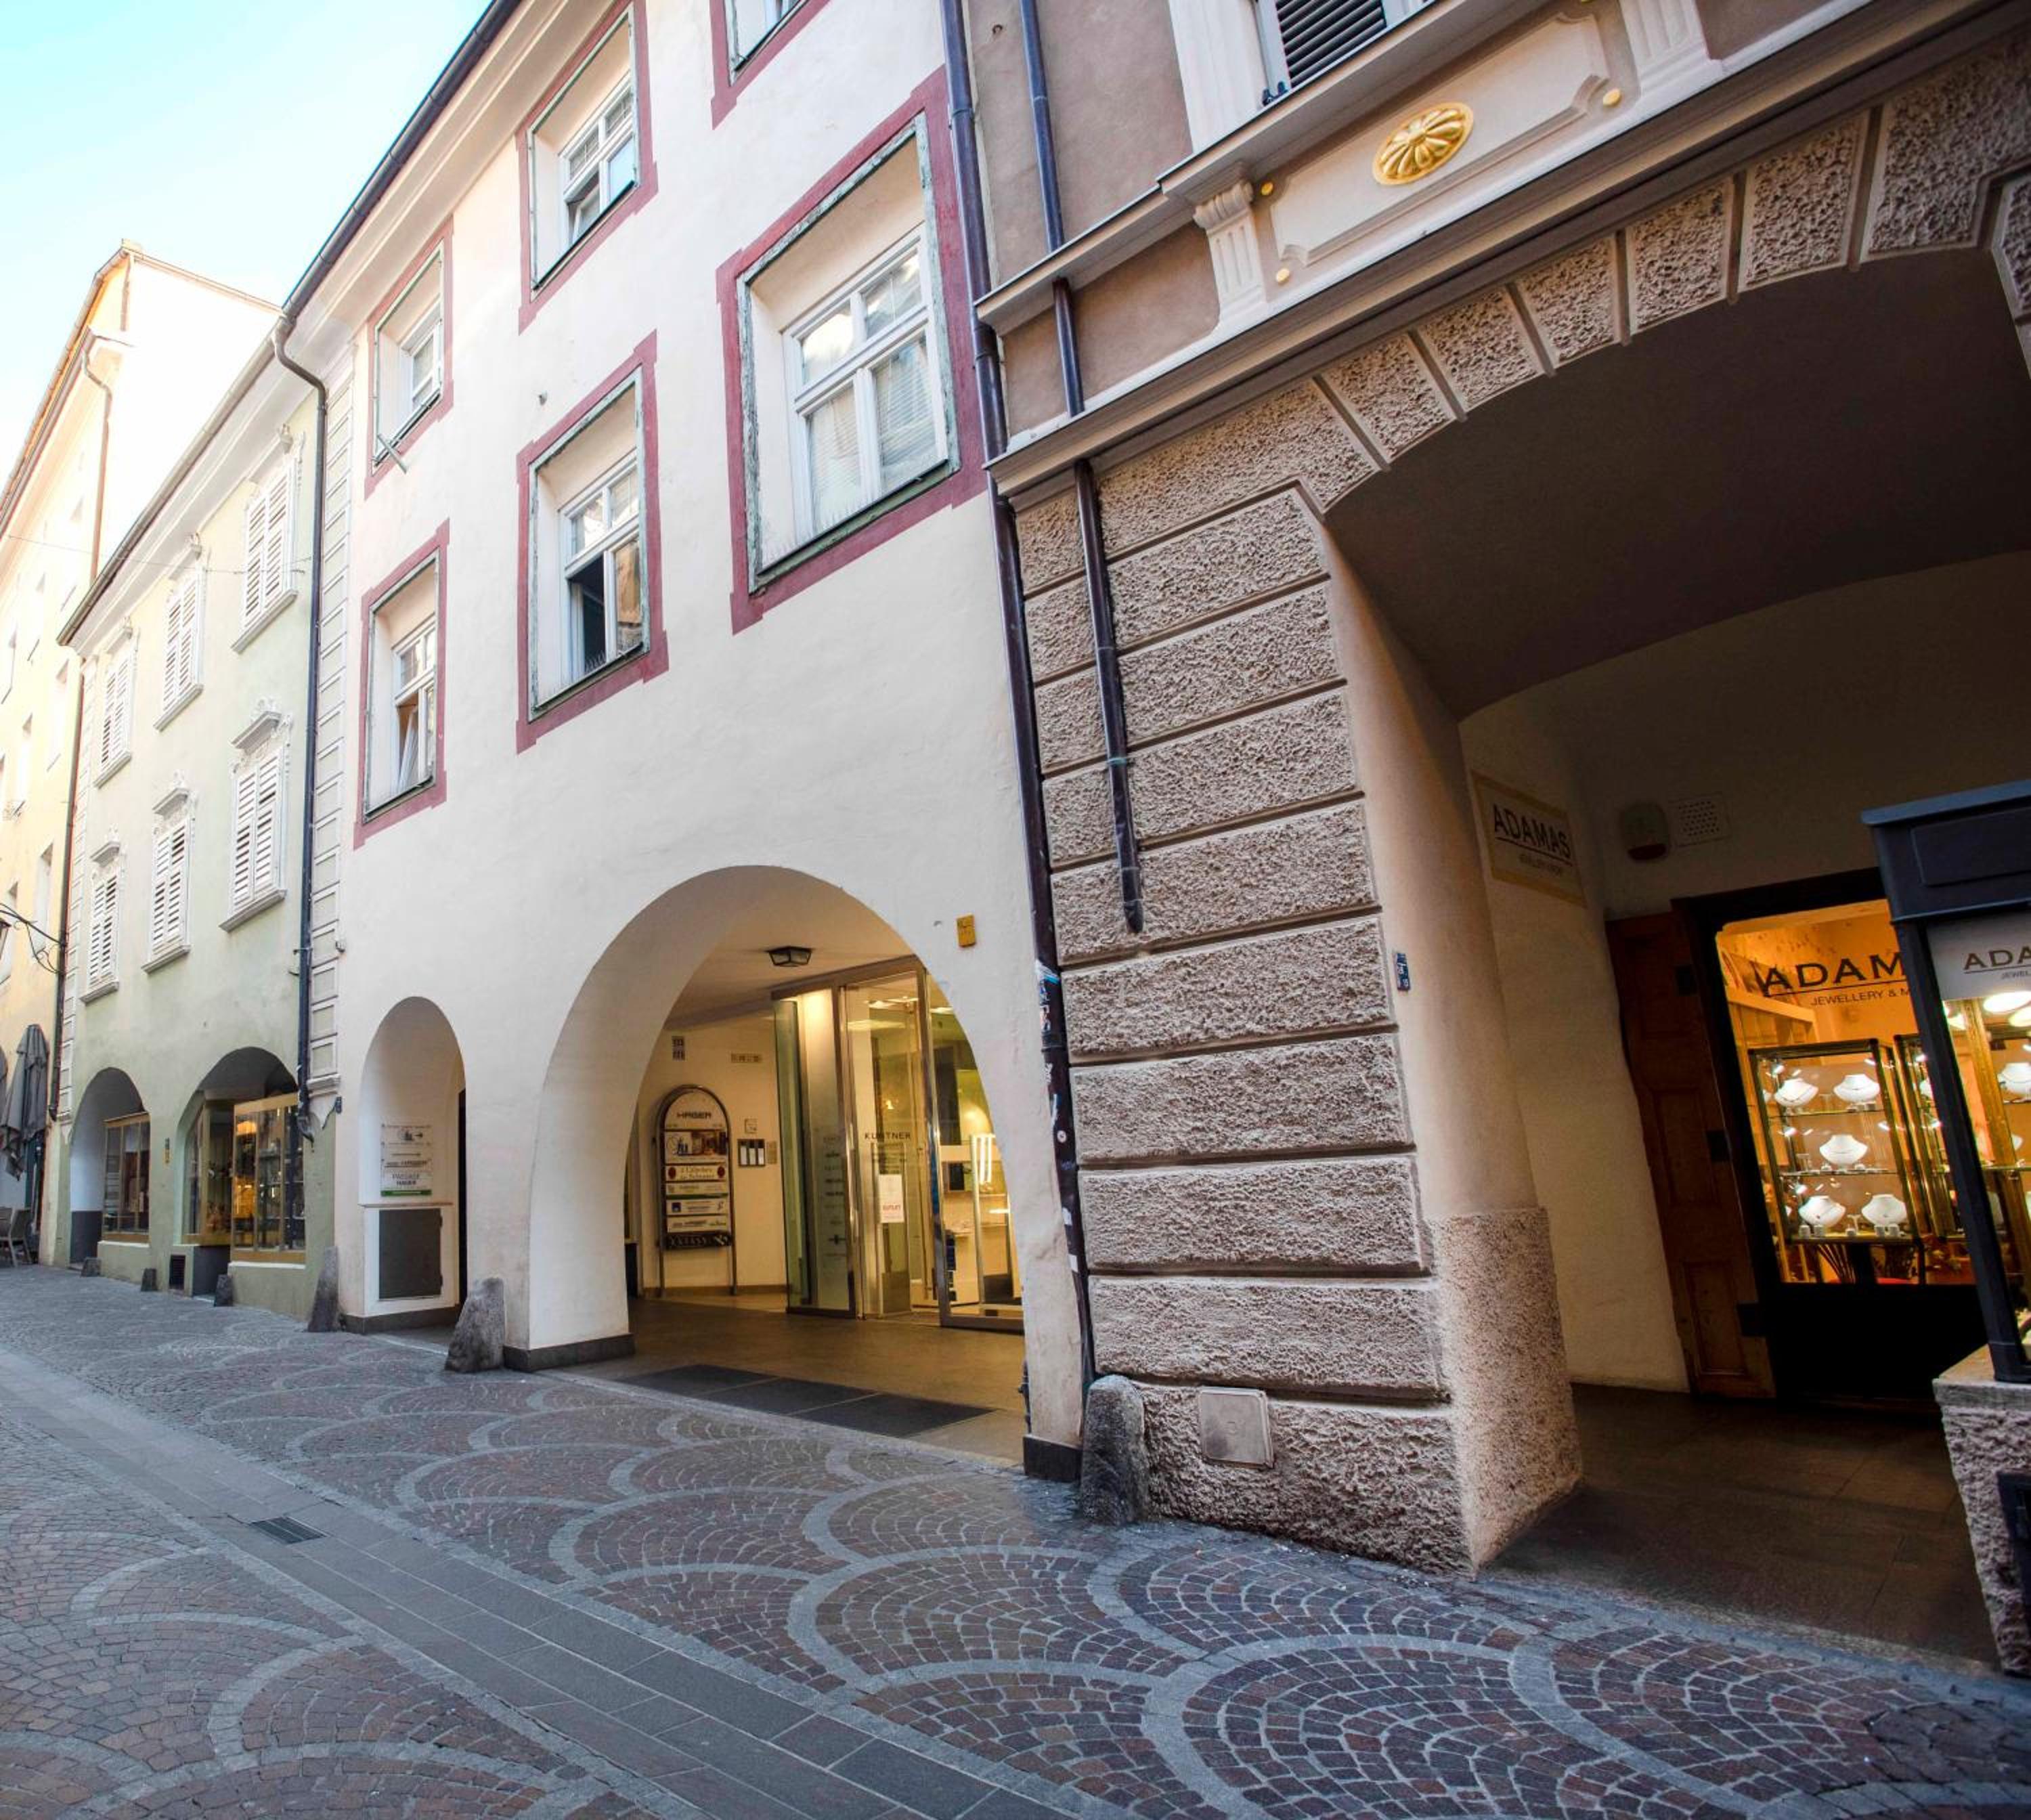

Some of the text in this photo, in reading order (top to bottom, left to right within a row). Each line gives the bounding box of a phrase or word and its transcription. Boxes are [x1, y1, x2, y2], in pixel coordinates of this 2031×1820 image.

[1493, 804, 1571, 859] ADAMAS
[1810, 991, 1884, 1006] JEWELLERY
[1888, 989, 1897, 997] &
[865, 1131, 911, 1140] KUTNER
